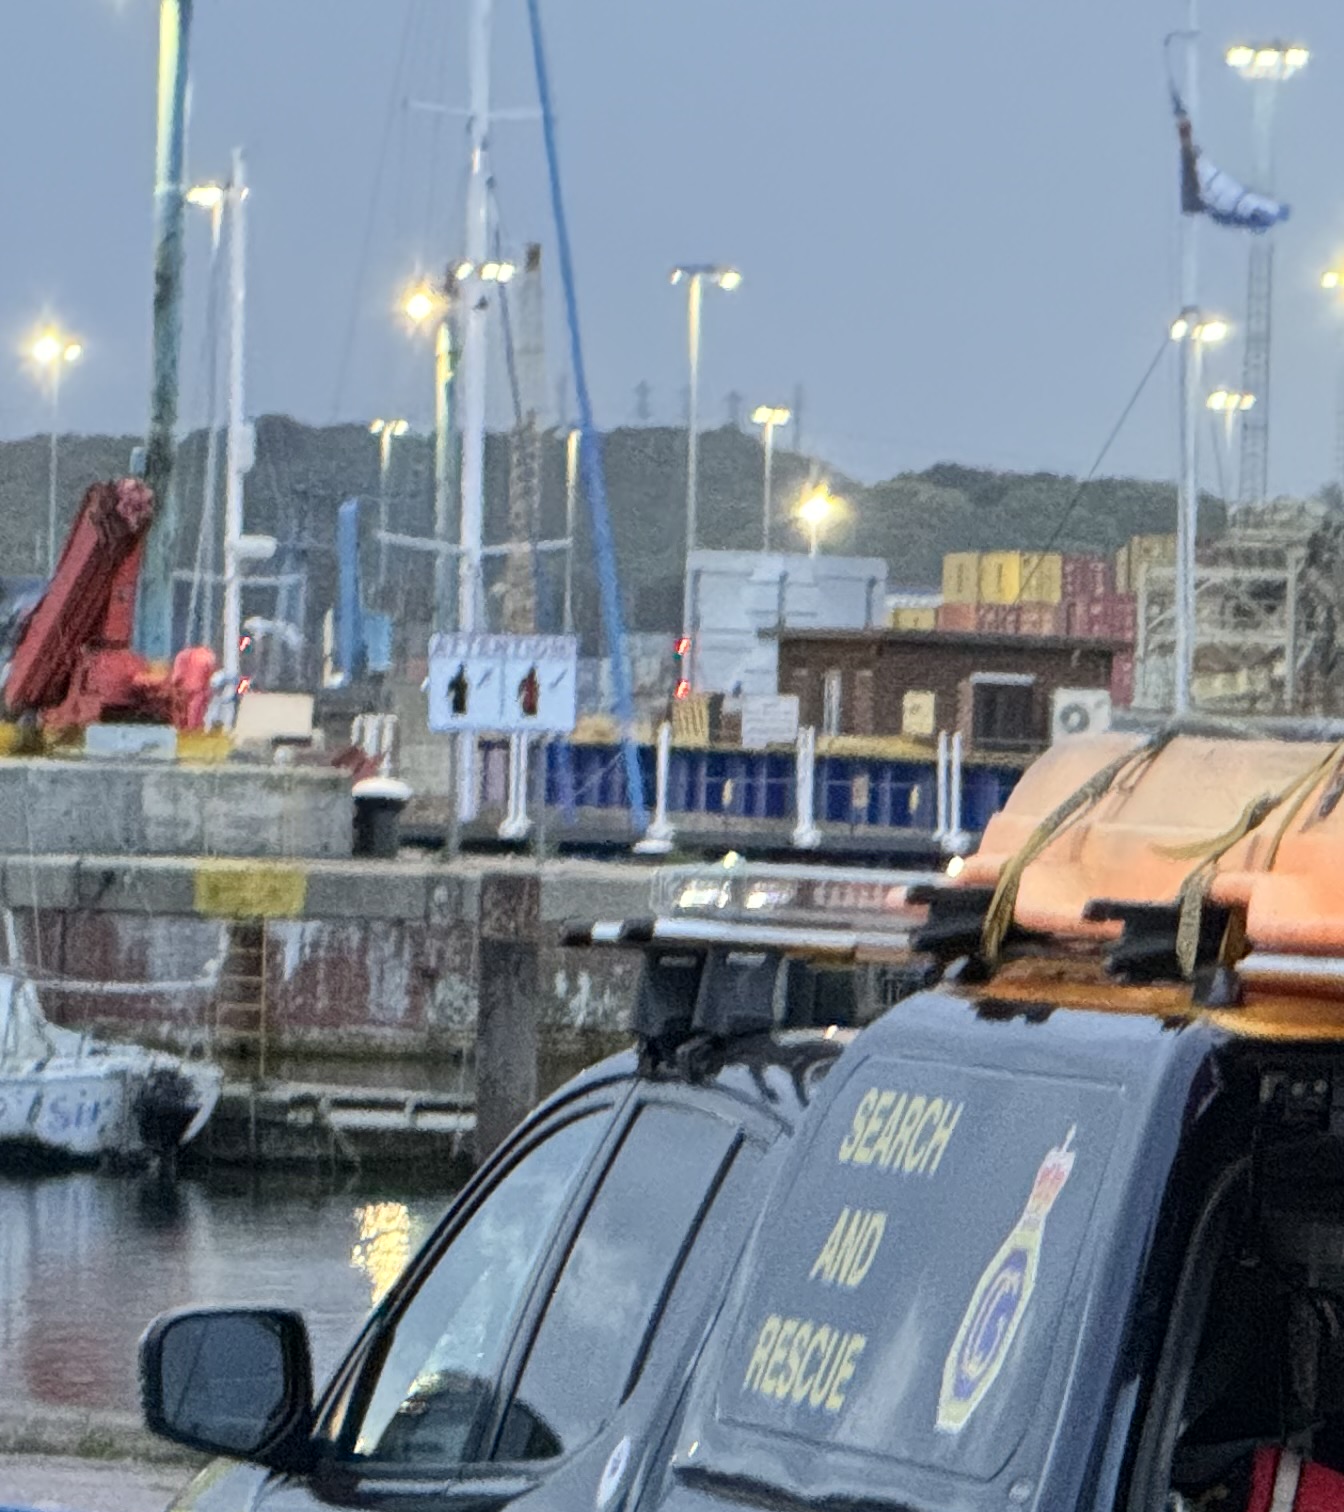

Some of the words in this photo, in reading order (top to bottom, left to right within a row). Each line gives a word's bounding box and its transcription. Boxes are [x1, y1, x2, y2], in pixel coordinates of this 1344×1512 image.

[840, 1087, 964, 1178] SEARCH
[809, 1207, 887, 1287] AND
[742, 1314, 866, 1412] RESCUE
